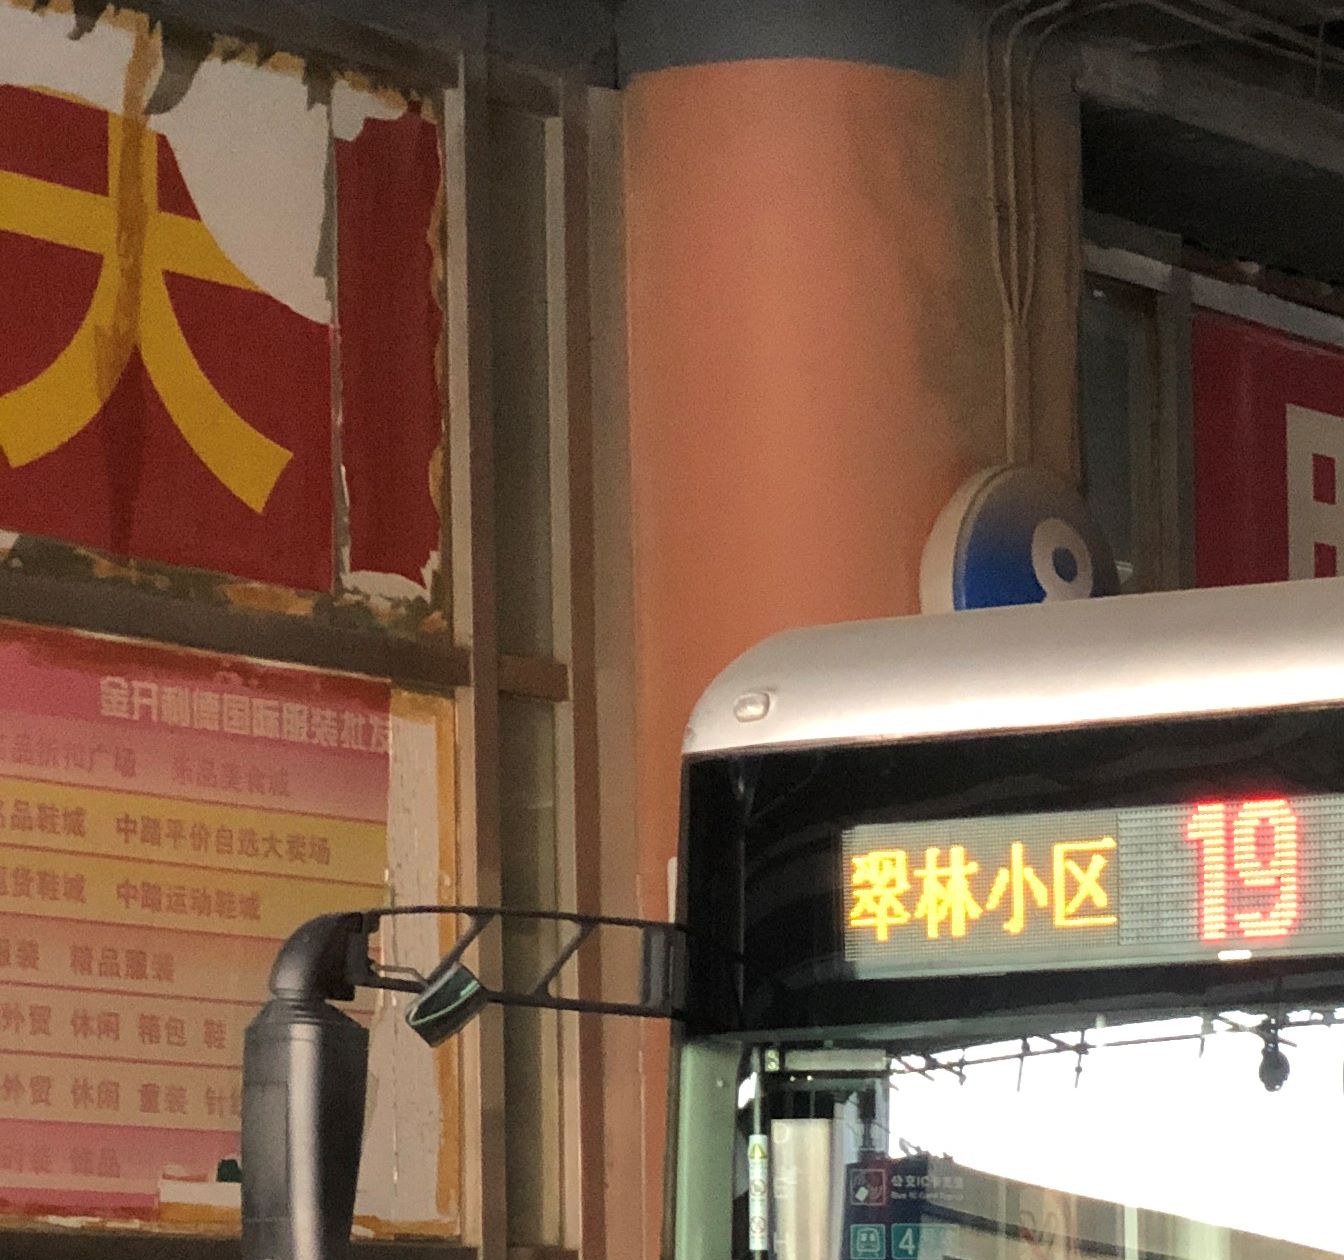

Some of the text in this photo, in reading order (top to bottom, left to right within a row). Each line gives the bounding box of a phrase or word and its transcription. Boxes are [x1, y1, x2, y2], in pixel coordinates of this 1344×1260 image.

[849, 837, 1116, 942] 翠林小区
[1185, 798, 1304, 942] 19
